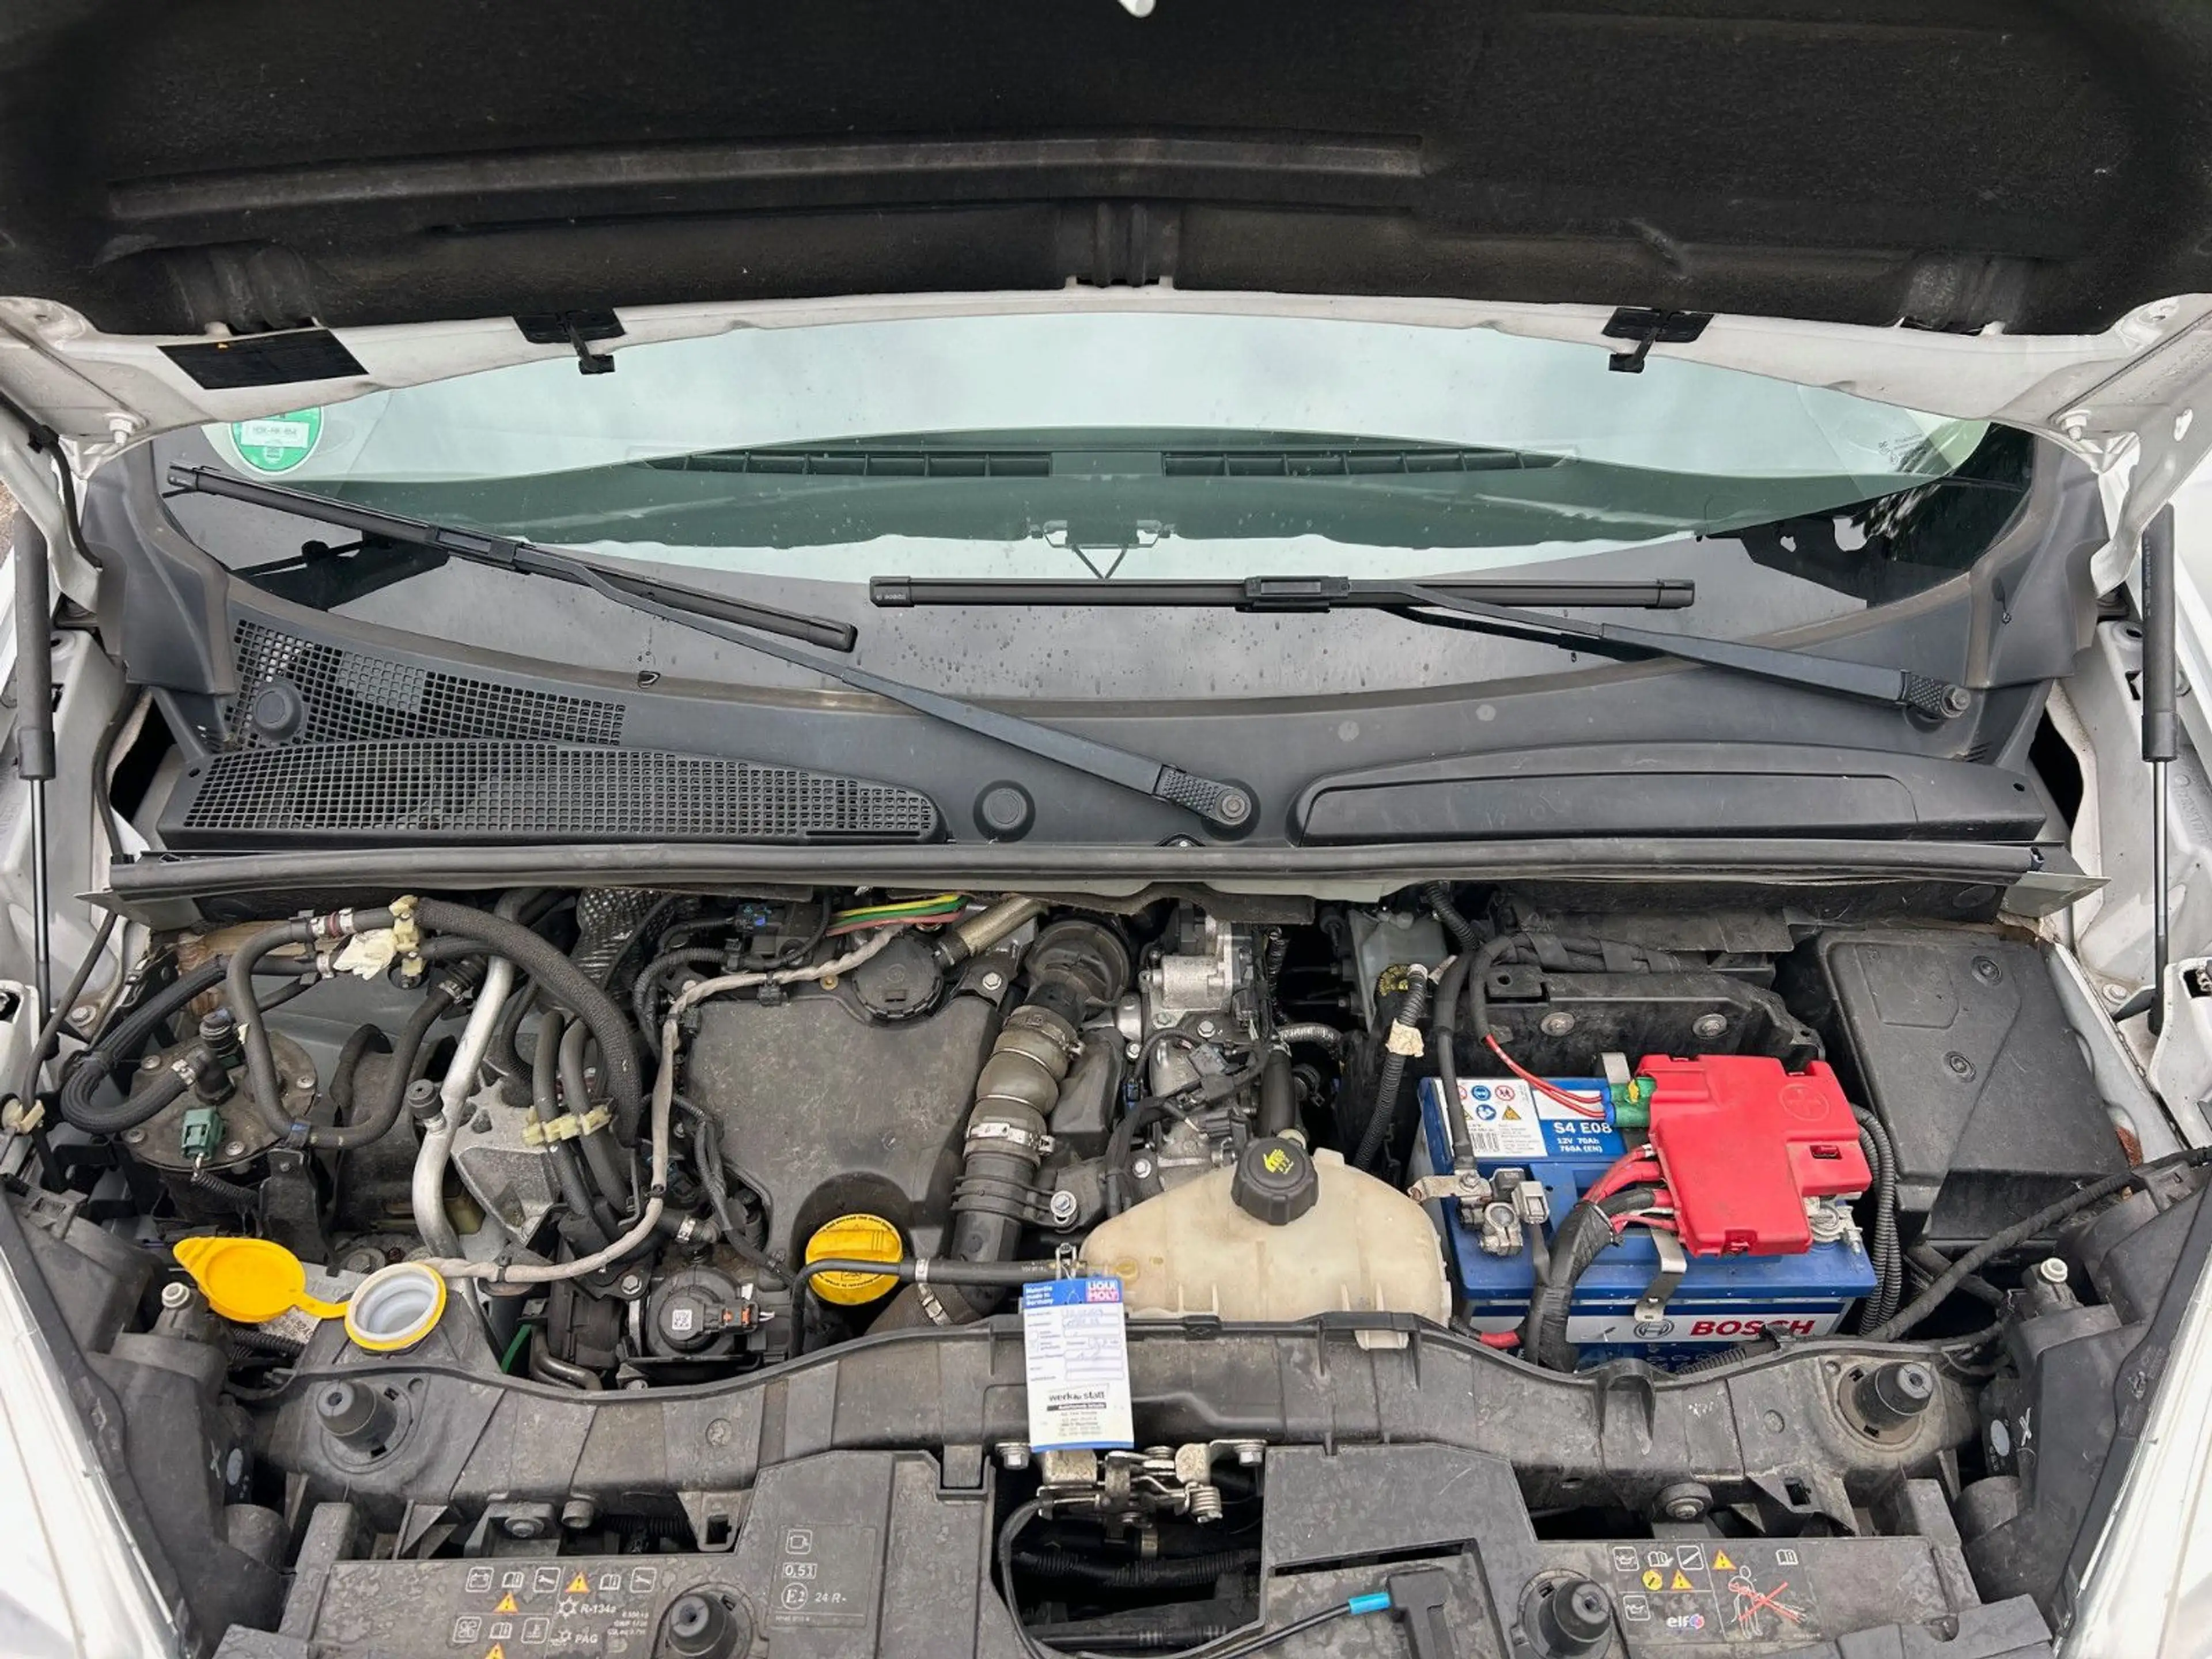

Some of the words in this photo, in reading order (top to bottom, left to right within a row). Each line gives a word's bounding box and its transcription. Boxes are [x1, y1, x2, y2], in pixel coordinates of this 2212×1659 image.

[1554, 1121, 1575, 1134] S4
[1580, 1122, 1612, 1134] E08
[1089, 1290, 1115, 1301] MOLY
[580, 1603, 616, 1613] R-134a
[1666, 1615, 1691, 1628] elf
[575, 1634, 599, 1643] PAG
